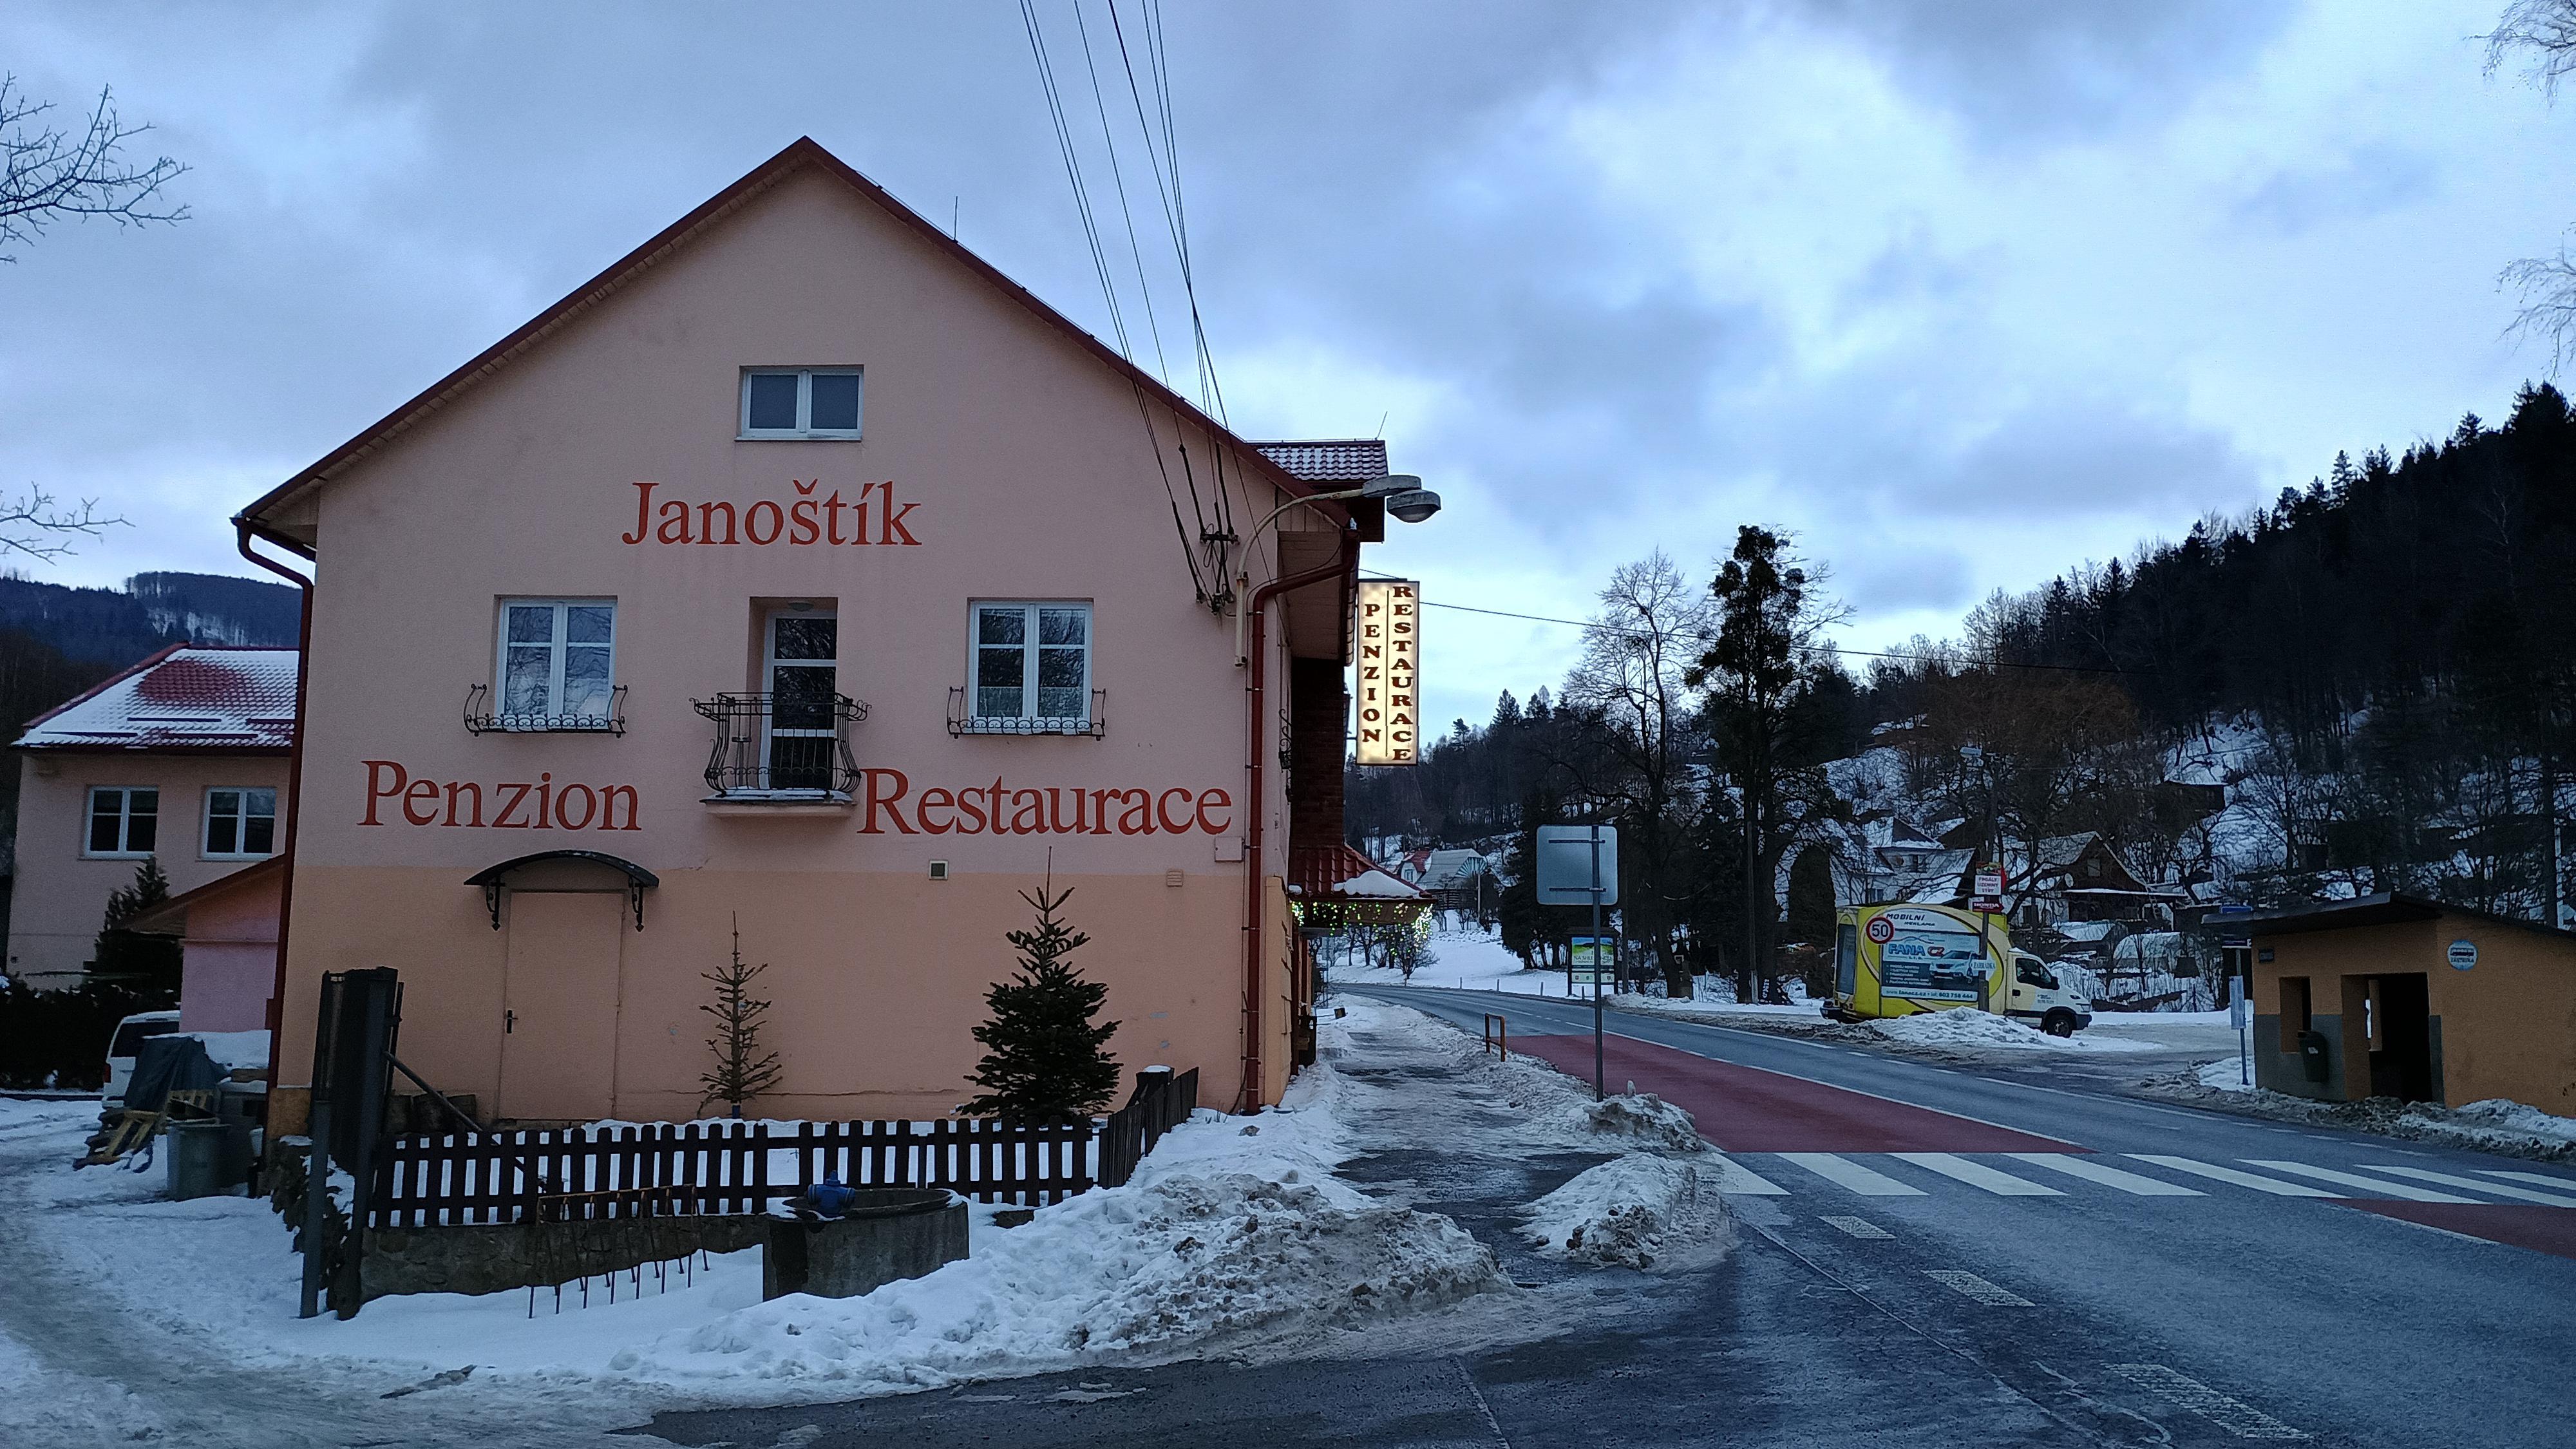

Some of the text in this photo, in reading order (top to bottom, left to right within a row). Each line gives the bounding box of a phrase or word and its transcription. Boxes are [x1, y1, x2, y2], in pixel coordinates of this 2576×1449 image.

[621, 478, 922, 545] Janoštík
[1361, 603, 1382, 743] PENZION
[1390, 585, 1414, 761] RESTAURACE
[356, 760, 1233, 835] Penzion Restaurace
[1871, 923, 1889, 938] 50
[1888, 943, 1945, 957] FANA CZ
